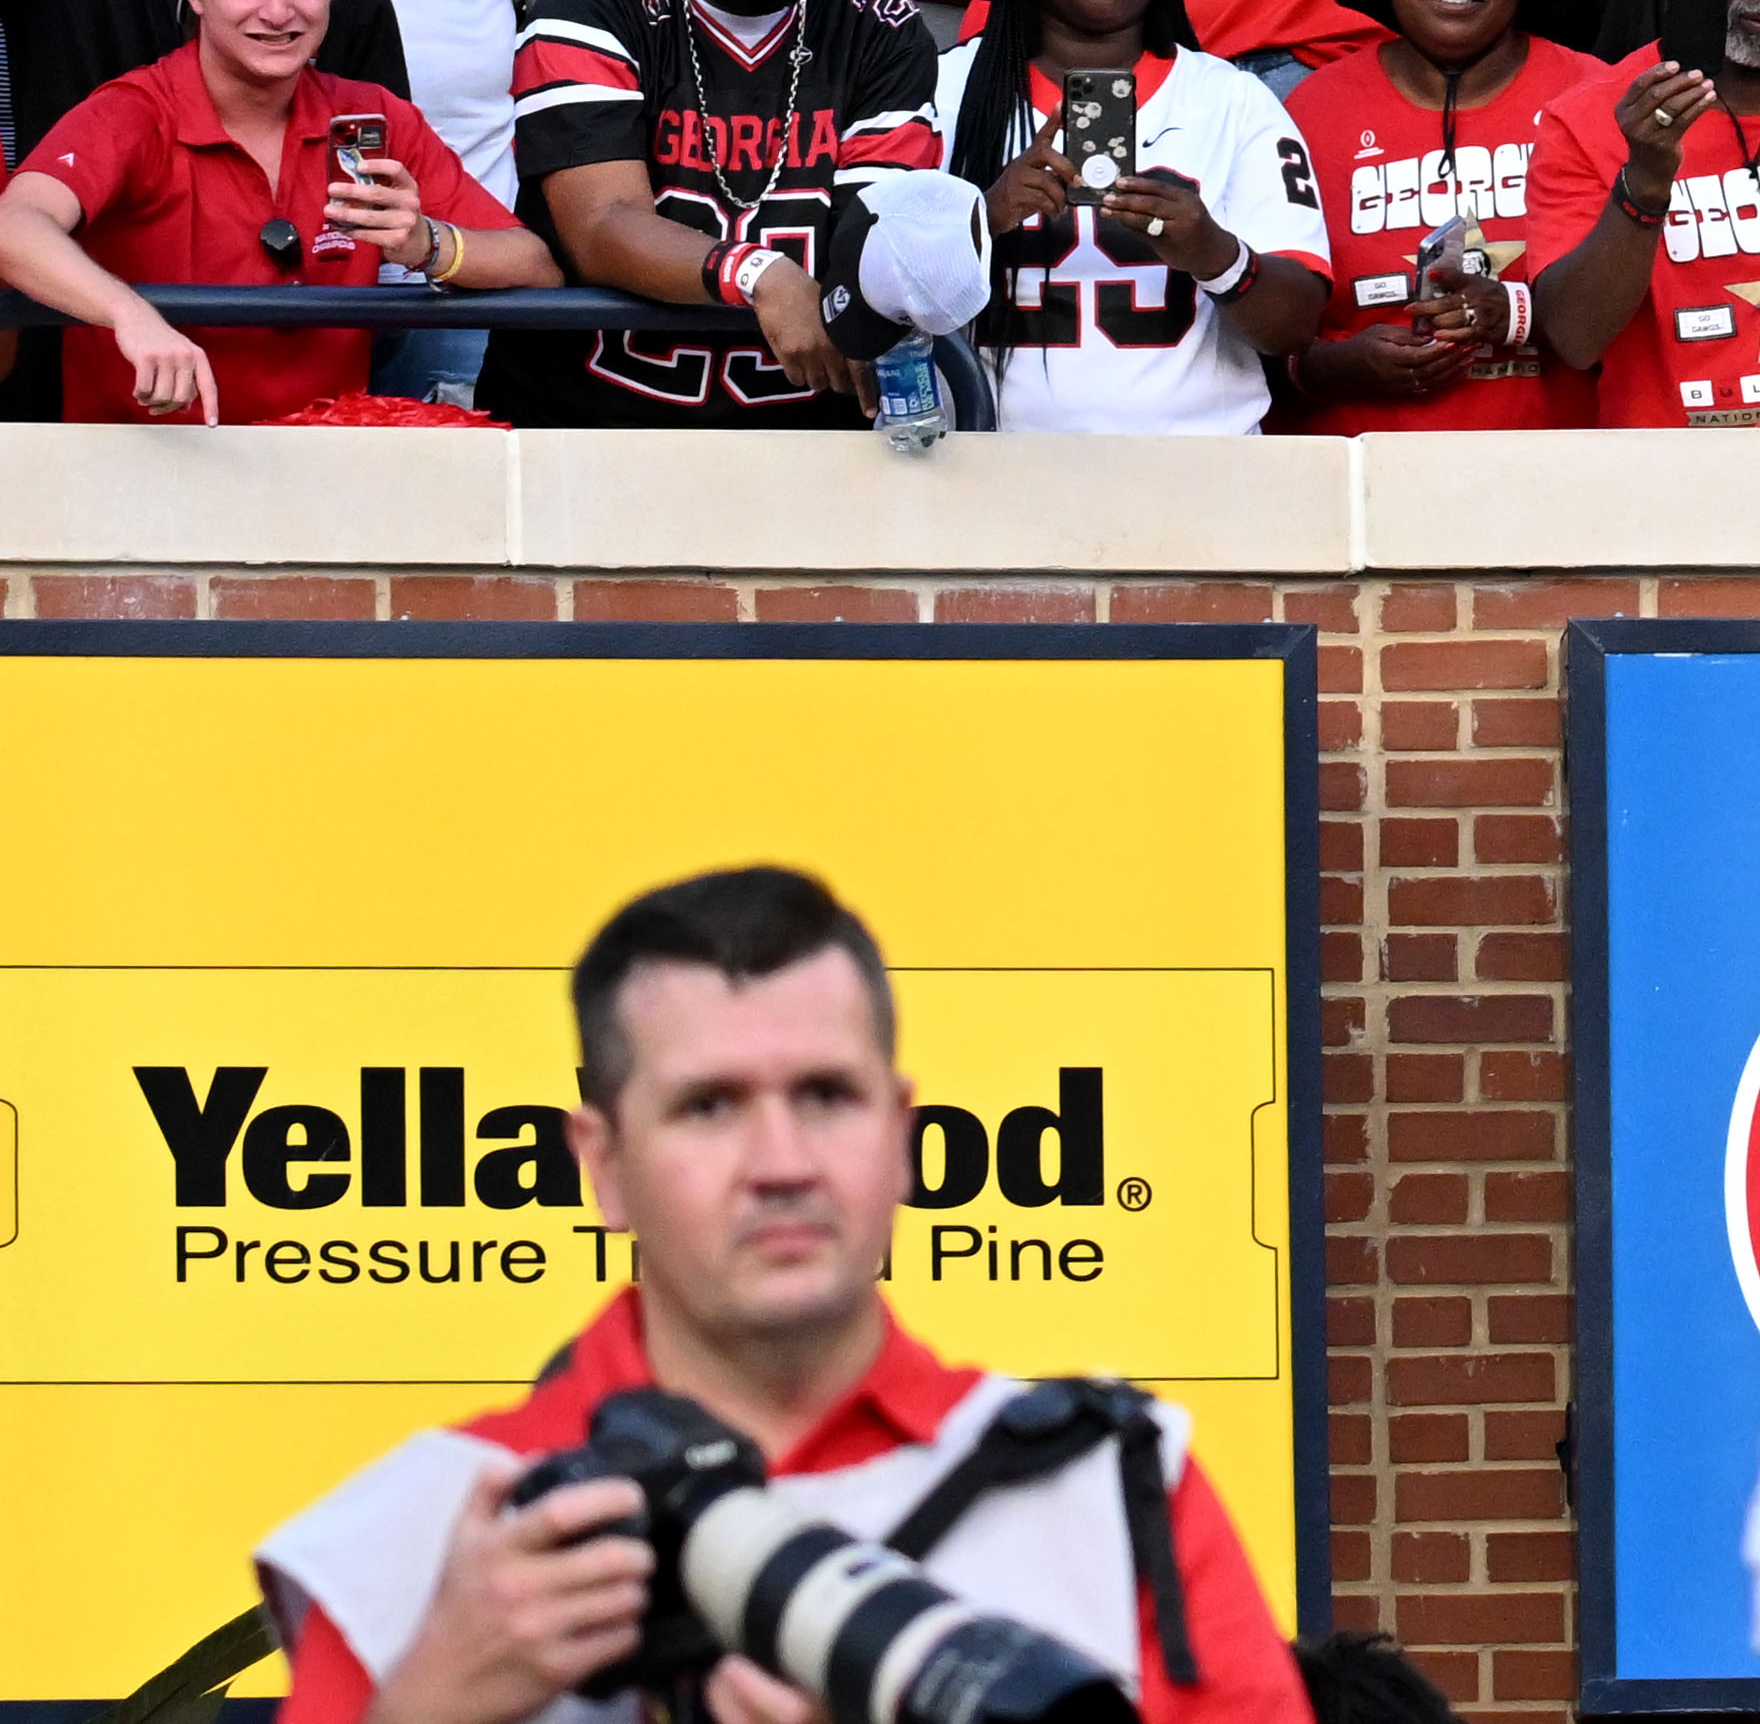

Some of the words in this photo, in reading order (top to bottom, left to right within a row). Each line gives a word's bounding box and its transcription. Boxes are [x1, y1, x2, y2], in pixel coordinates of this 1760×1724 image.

[656, 108, 838, 172] GEORGIA
[1516, 289, 1527, 343] GEORGI
[132, 1065, 1104, 1209] Yellaod
[177, 1224, 545, 1283] Pressure
[932, 1224, 1104, 1281] Pine
